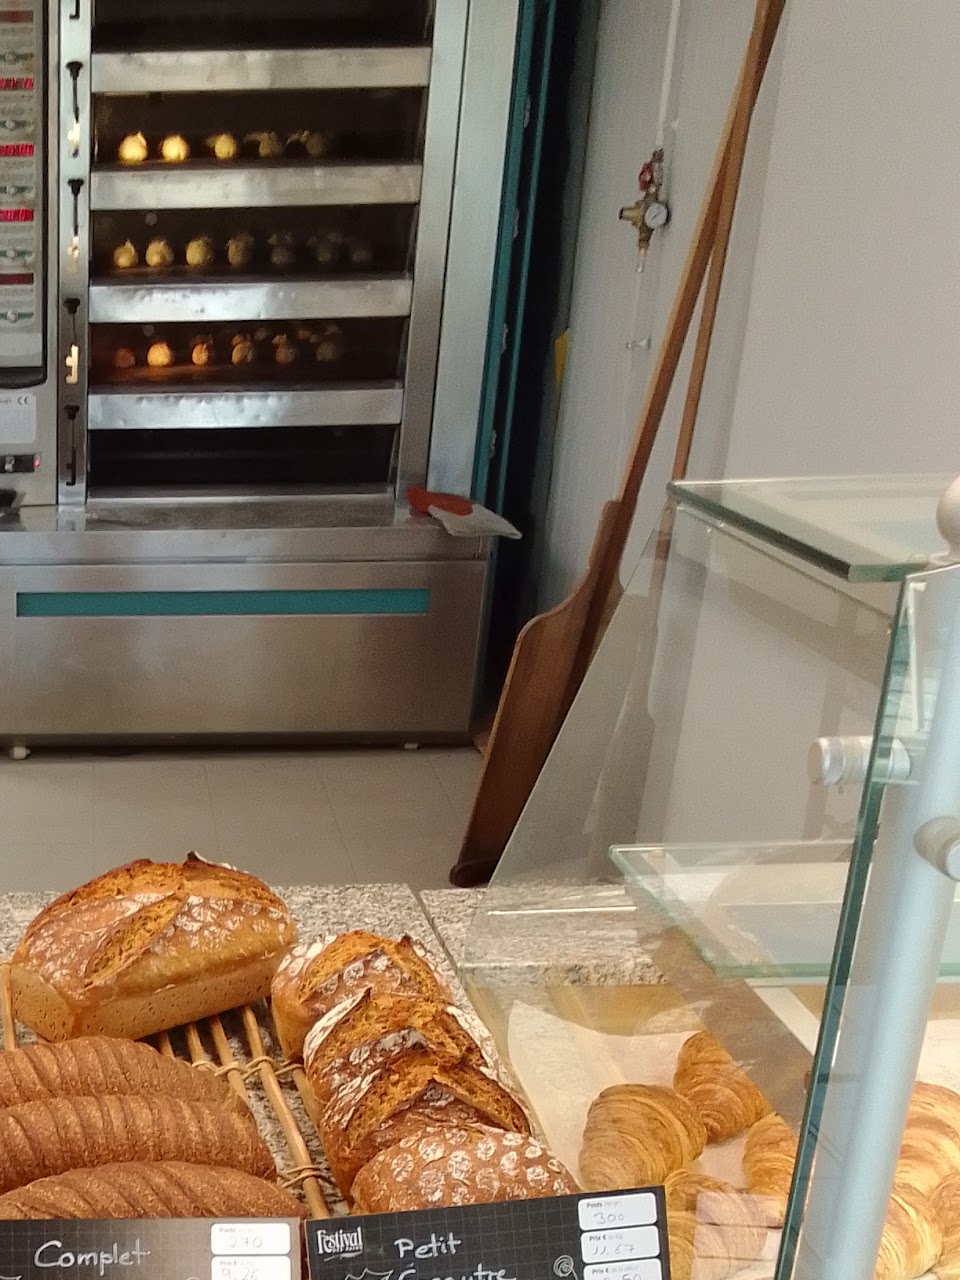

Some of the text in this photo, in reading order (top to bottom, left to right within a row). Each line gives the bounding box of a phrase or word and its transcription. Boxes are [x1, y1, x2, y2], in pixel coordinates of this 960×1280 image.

[593, 1212, 625, 1225] 300
[316, 1226, 364, 1255] Festival
[393, 1231, 461, 1259] Petit
[34, 1238, 151, 1276] Complet
